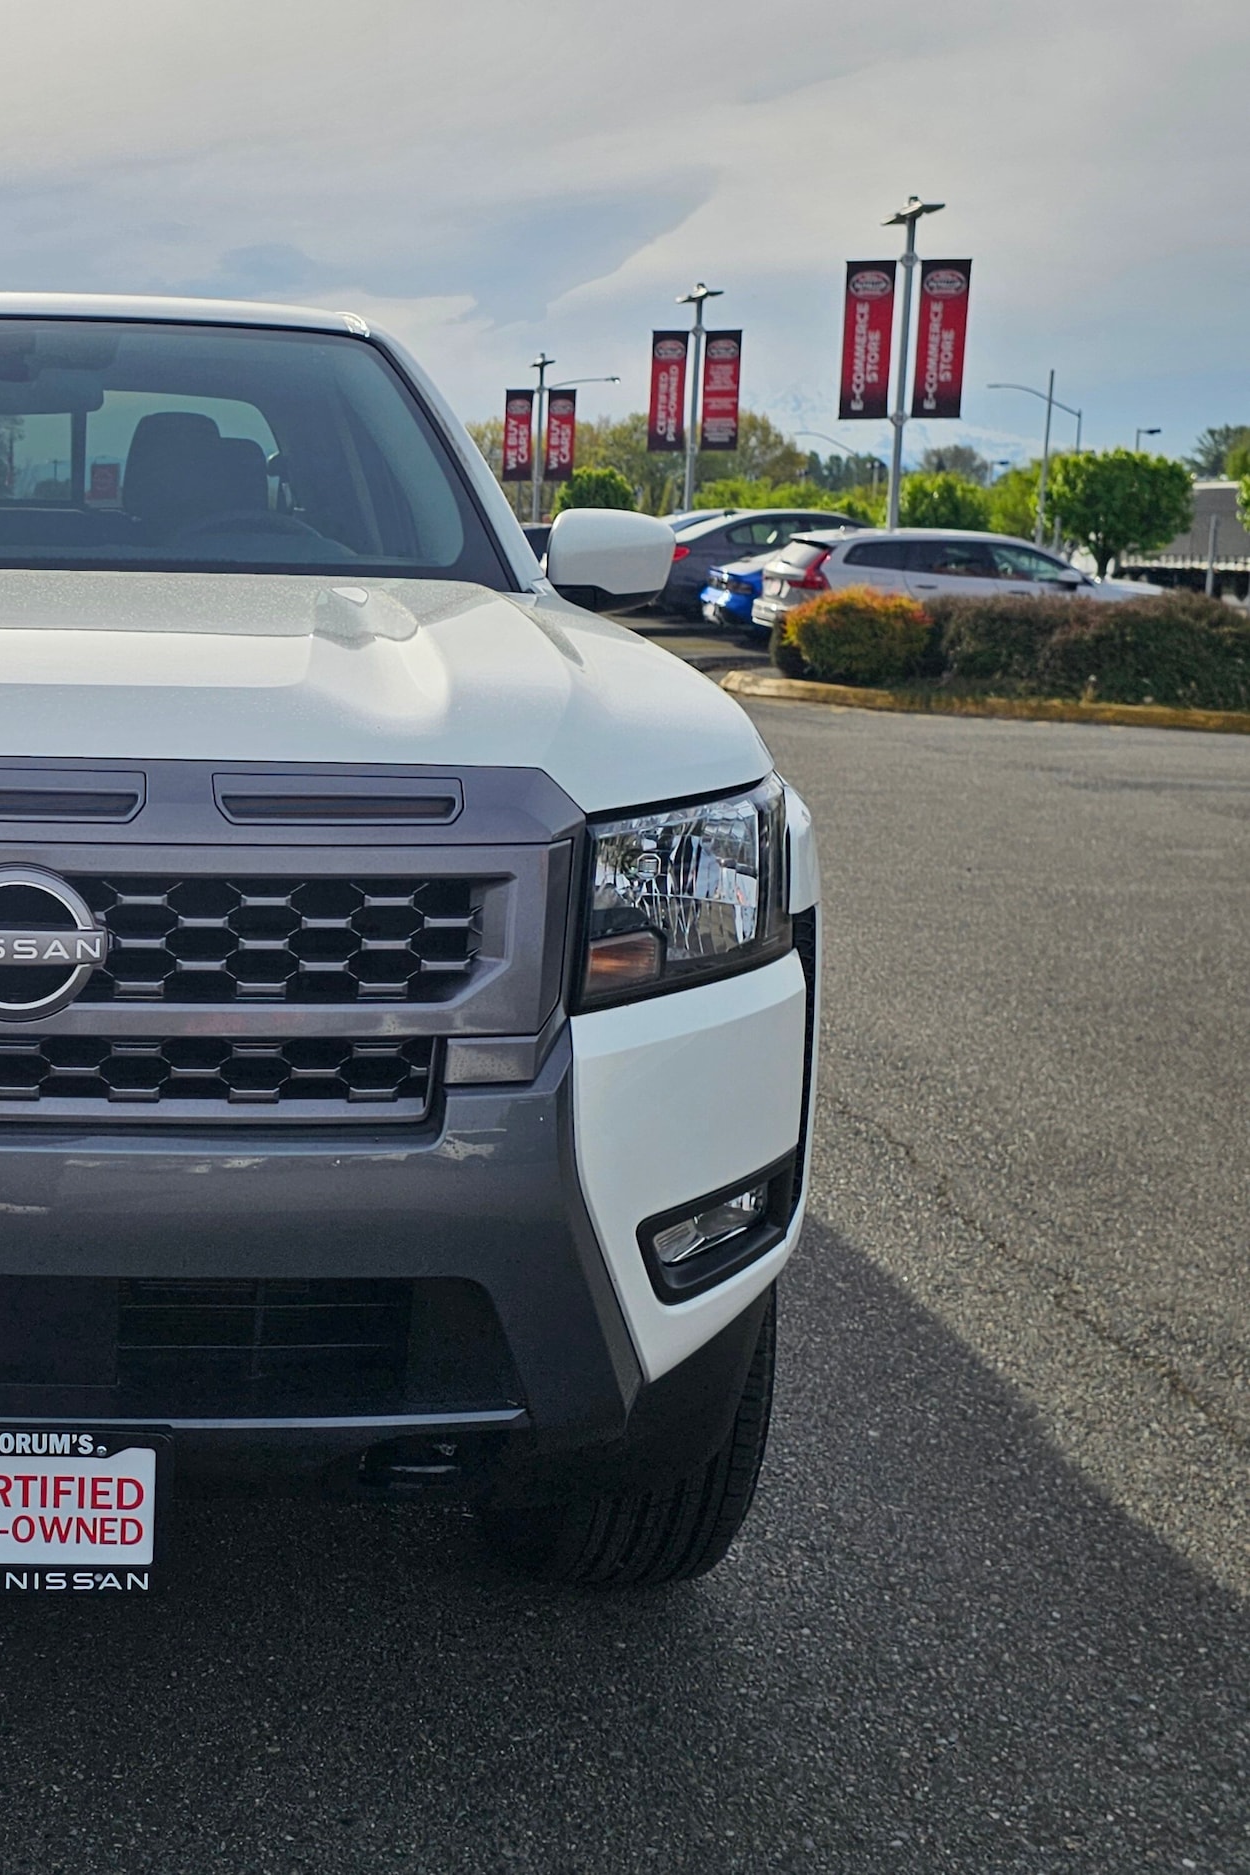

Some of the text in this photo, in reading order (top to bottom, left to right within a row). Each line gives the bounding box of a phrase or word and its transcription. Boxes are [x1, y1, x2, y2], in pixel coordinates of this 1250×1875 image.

[851, 302, 869, 411] E-COMMERCE
[866, 329, 881, 383] STORE
[923, 301, 943, 410] E-COMMERCE
[939, 328, 955, 382] STORE
[657, 371, 668, 435] CERTIFIED
[666, 365, 679, 442] PRE-OWNED
[506, 418, 518, 470] WE BUY
[548, 418, 560, 470] WE BUY
[5, 1571, 149, 1591] NISSAN
